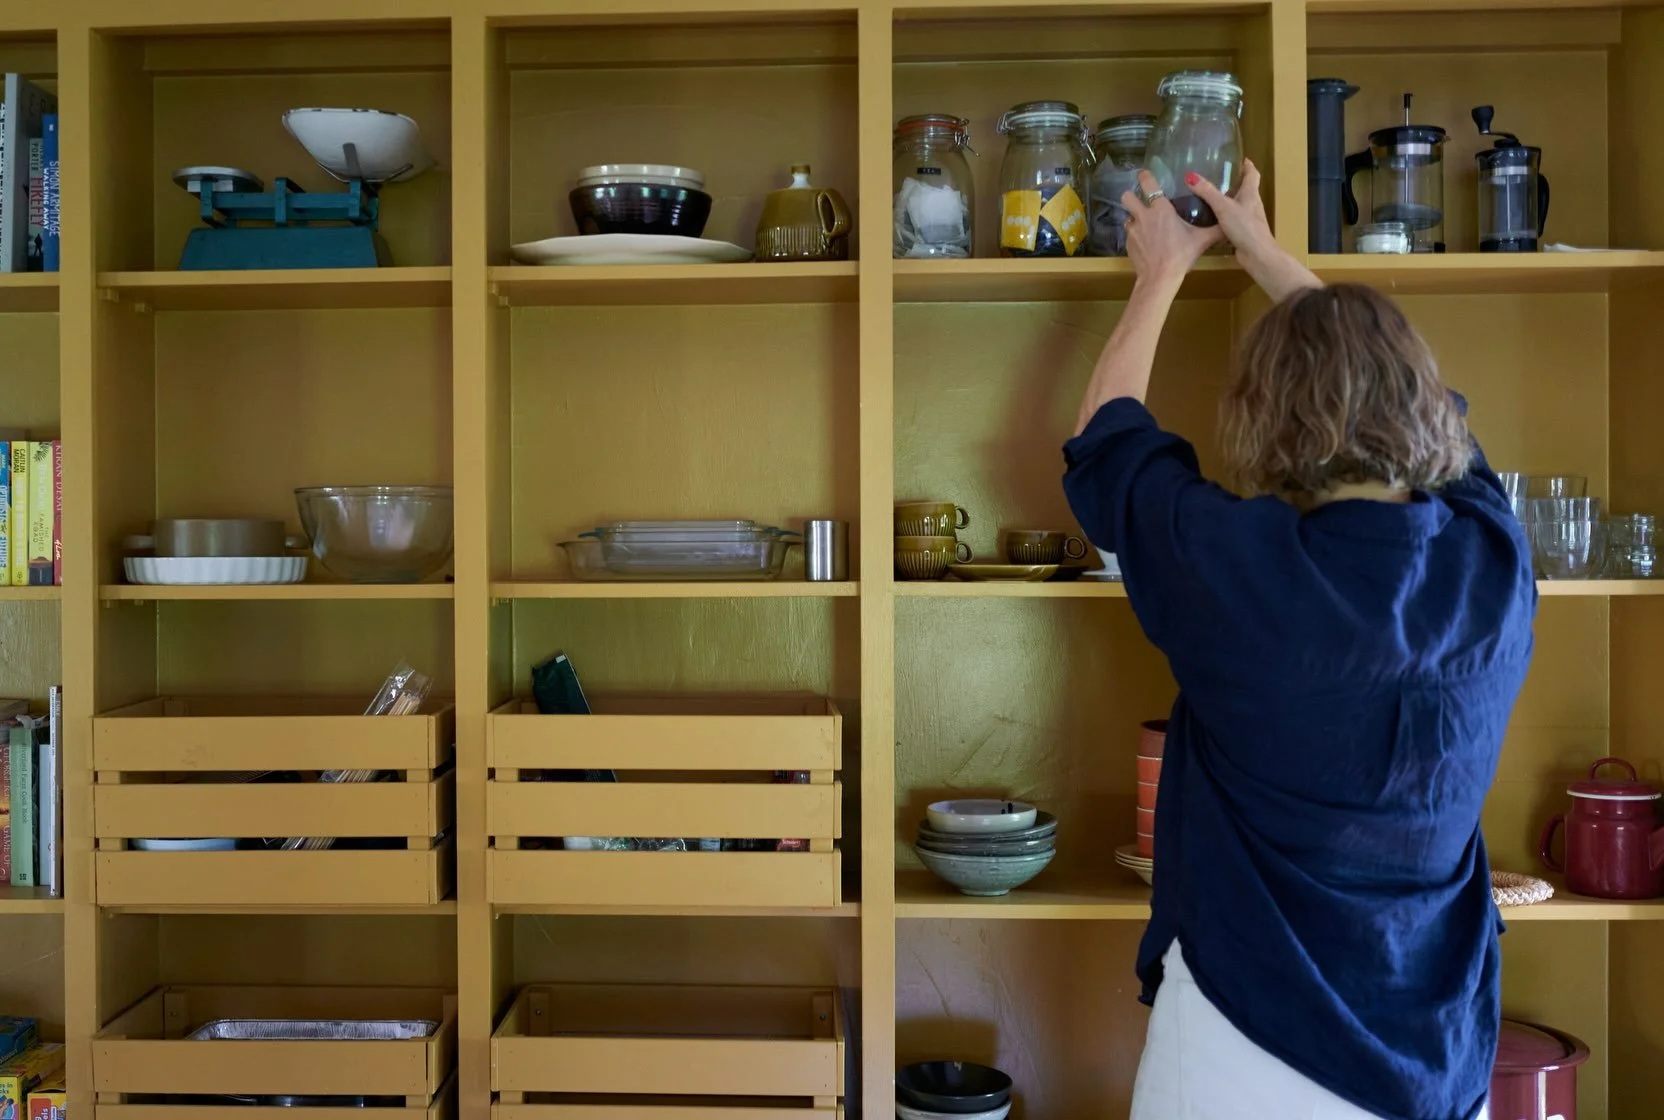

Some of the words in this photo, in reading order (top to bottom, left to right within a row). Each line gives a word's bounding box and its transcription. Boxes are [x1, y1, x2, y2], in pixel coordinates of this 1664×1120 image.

[31, 143, 39, 171] PORTER
[49, 160, 60, 190] SIMON
[30, 177, 43, 227] FIREFLY
[49, 193, 60, 237] ARMITAGE
